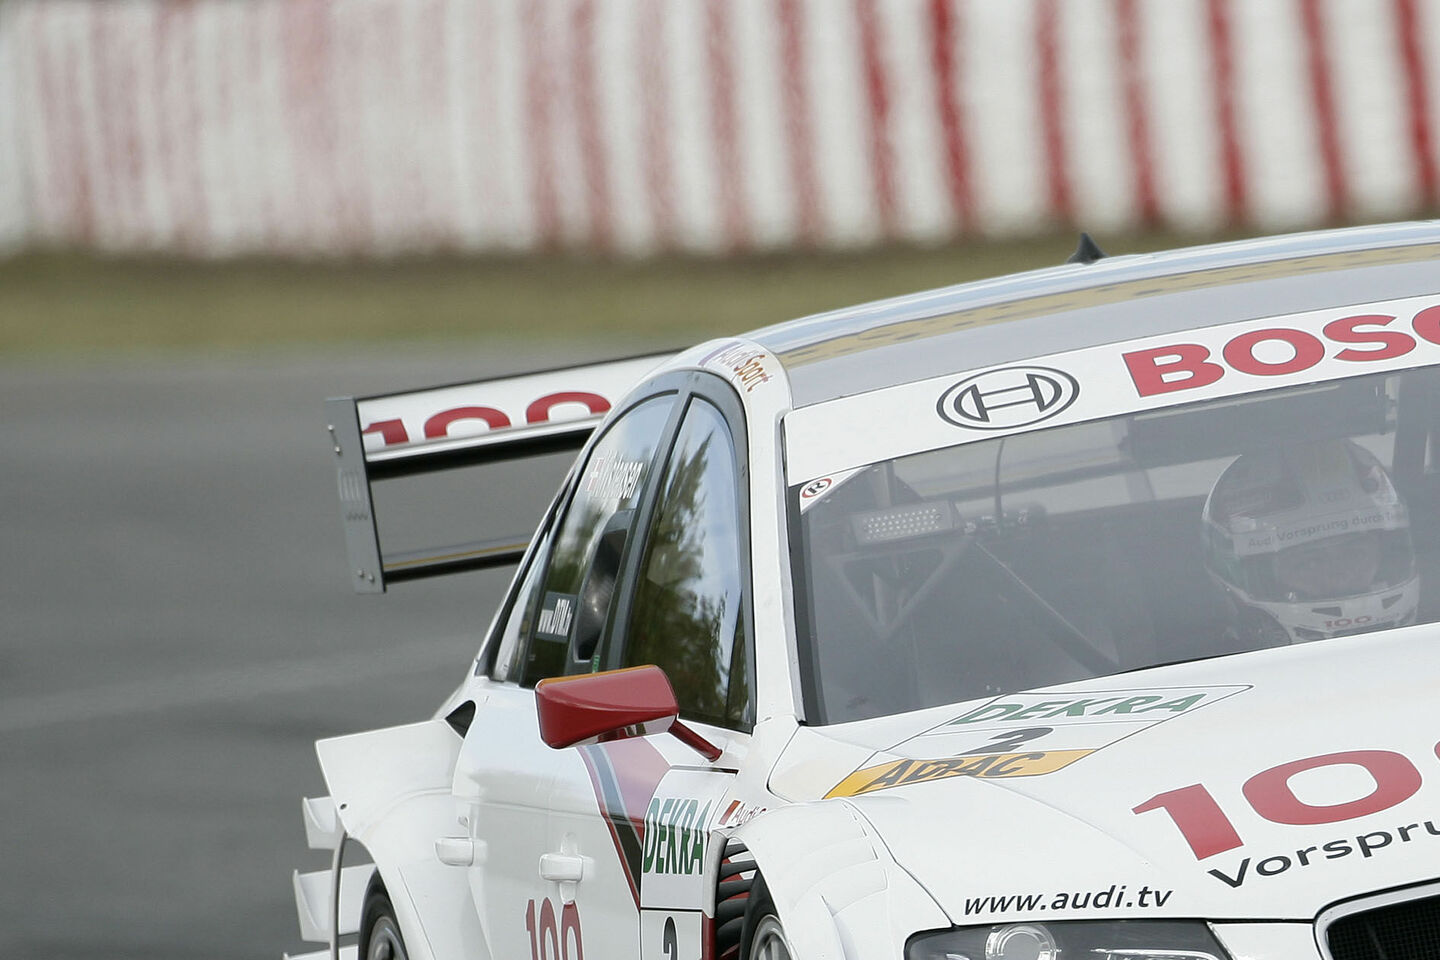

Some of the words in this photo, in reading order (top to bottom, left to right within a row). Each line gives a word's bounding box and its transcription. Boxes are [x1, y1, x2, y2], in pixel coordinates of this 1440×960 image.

[1324, 615, 1372, 628] 100
[947, 694, 1206, 725] DEKRA
[954, 727, 1054, 755] 2
[853, 752, 1047, 793] ADAC
[643, 798, 713, 875] DEKRA
[963, 885, 1174, 916] www.audi.tv
